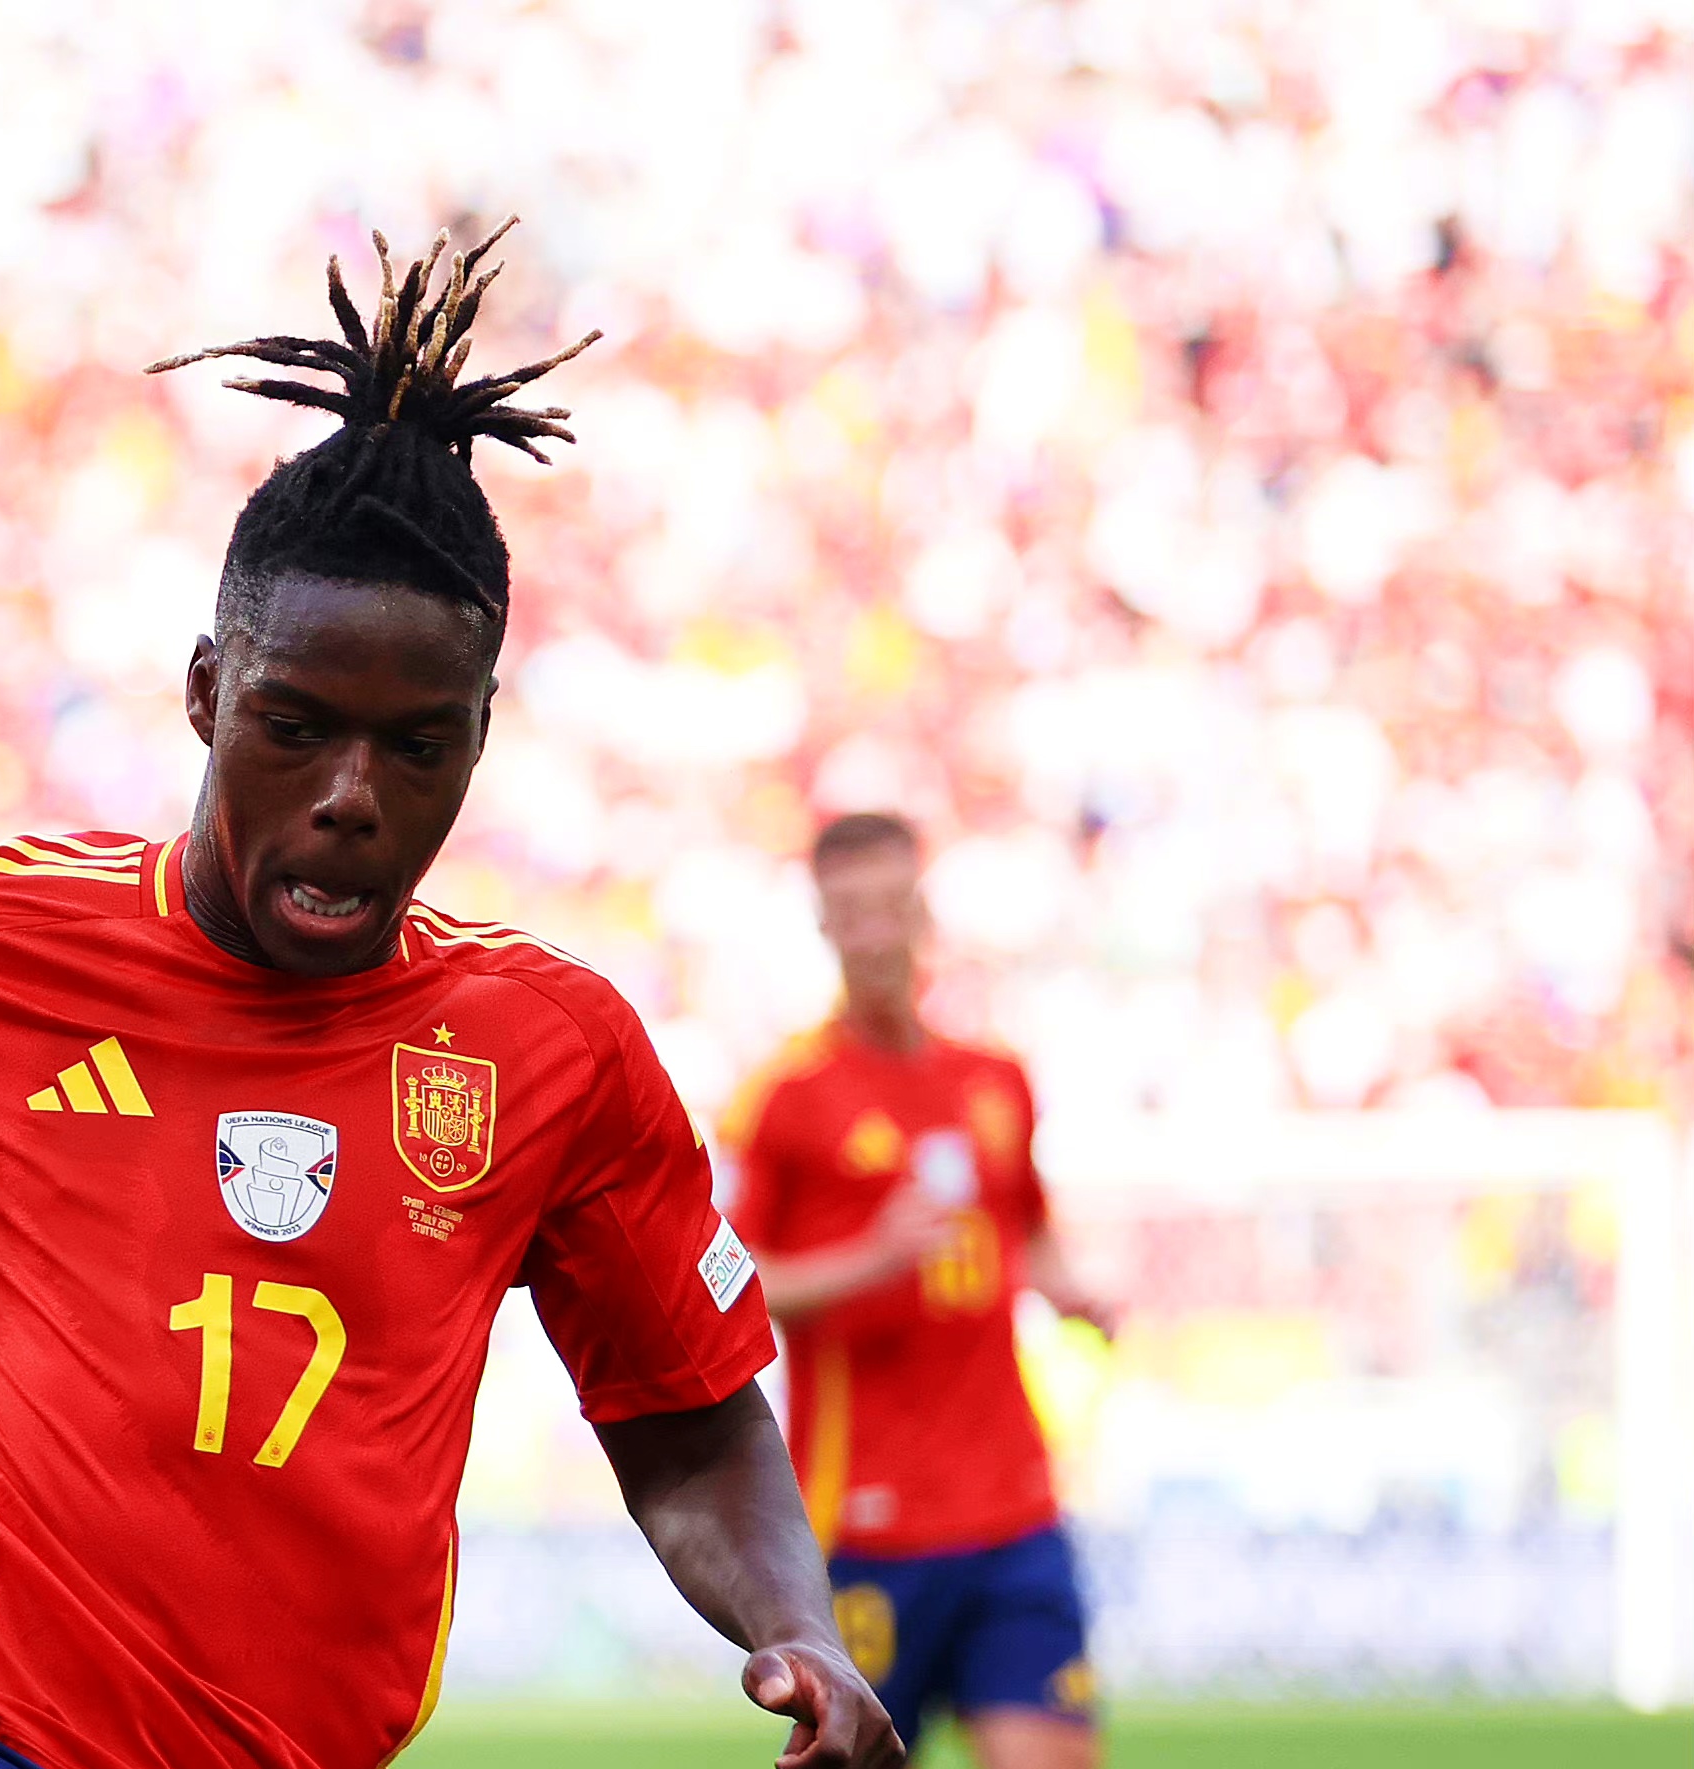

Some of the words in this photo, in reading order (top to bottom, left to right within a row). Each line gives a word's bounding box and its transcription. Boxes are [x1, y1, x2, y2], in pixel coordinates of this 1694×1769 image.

[225, 1116, 249, 1124] UEFA
[251, 1116, 293, 1125] NATIONS
[295, 1119, 332, 1135] LEAGUE
[244, 1217, 279, 1236] WINNER
[169, 1272, 348, 1468] 17
